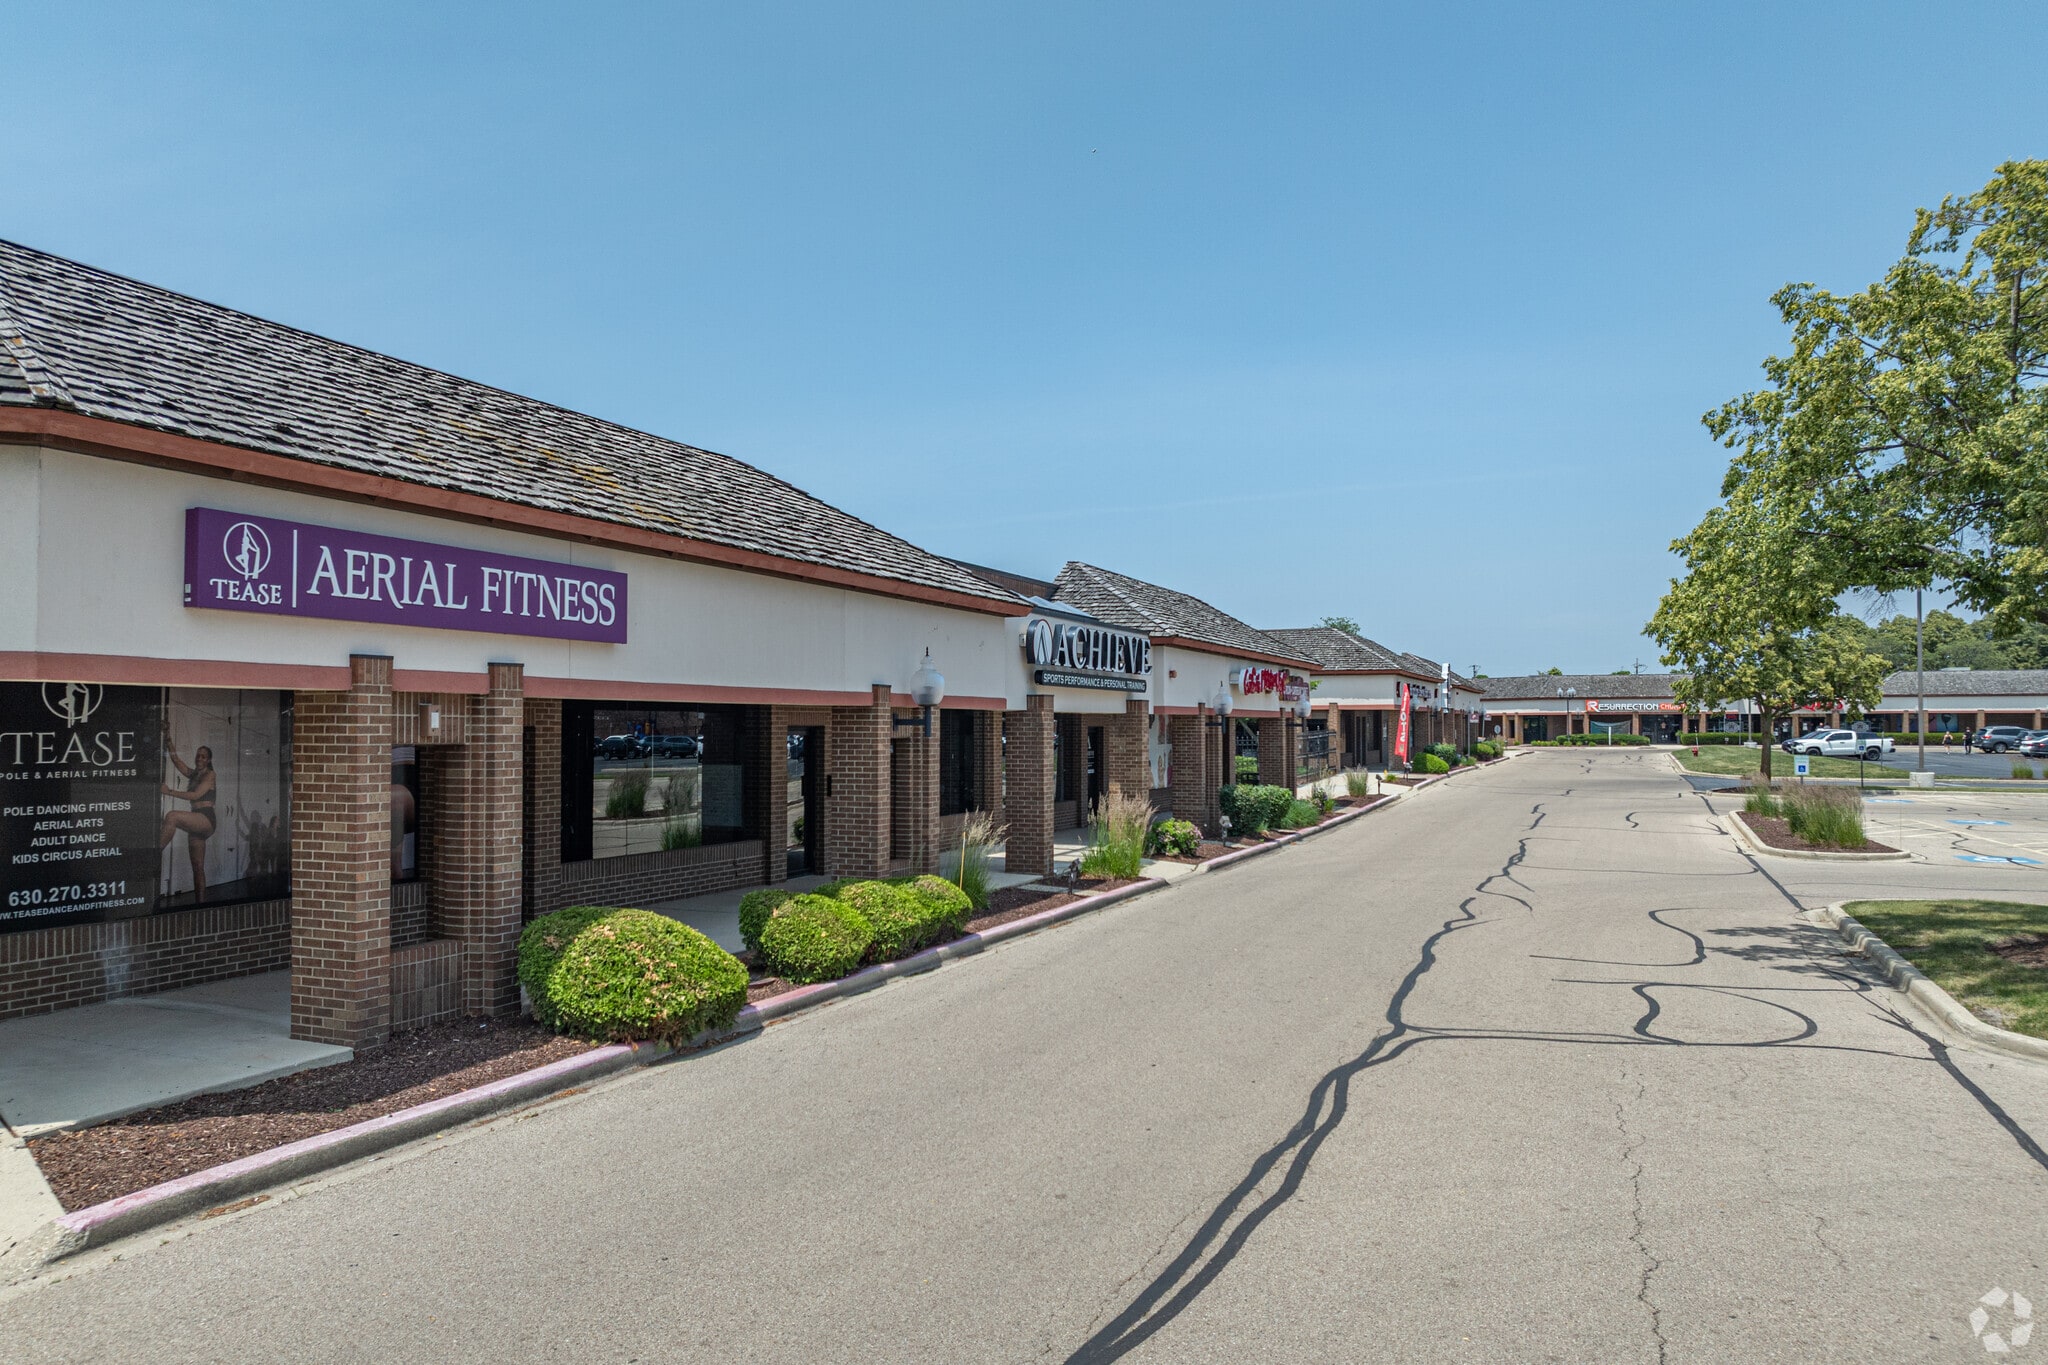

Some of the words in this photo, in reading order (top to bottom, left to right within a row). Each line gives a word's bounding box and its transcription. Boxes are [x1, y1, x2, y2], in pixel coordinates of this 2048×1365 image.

[210, 578, 282, 606] TEASE
[306, 545, 468, 610] AERIAL
[480, 566, 616, 626] FITNESS
[1052, 624, 1152, 676] ACHIEVE
[1043, 673, 1064, 684] SPORTS
[1064, 676, 1100, 687] PERFORMANCE
[1104, 680, 1126, 689] PERSONAL
[1126, 681, 1146, 691] TRAINING
[1587, 700, 1659, 712] RESURRECTION
[0, 731, 137, 767] TEASE
[0, 772, 29, 781] POLE
[34, 771, 41, 780] &
[46, 770, 88, 779] AERIAL
[92, 769, 137, 778] FITNESS
[3, 805, 34, 817] POLE
[37, 803, 87, 816] DANCING
[89, 801, 131, 813] FITNESS
[33, 820, 74, 831] AERIAL
[75, 818, 104, 828] ARTS
[30, 836, 67, 848] ADULT
[69, 833, 106, 845] DANCE
[12, 853, 40, 865] KIDS
[42, 850, 83, 863] CIRCUS
[84, 847, 122, 859] AERIAL
[8, 880, 127, 907] 630.270.3311
